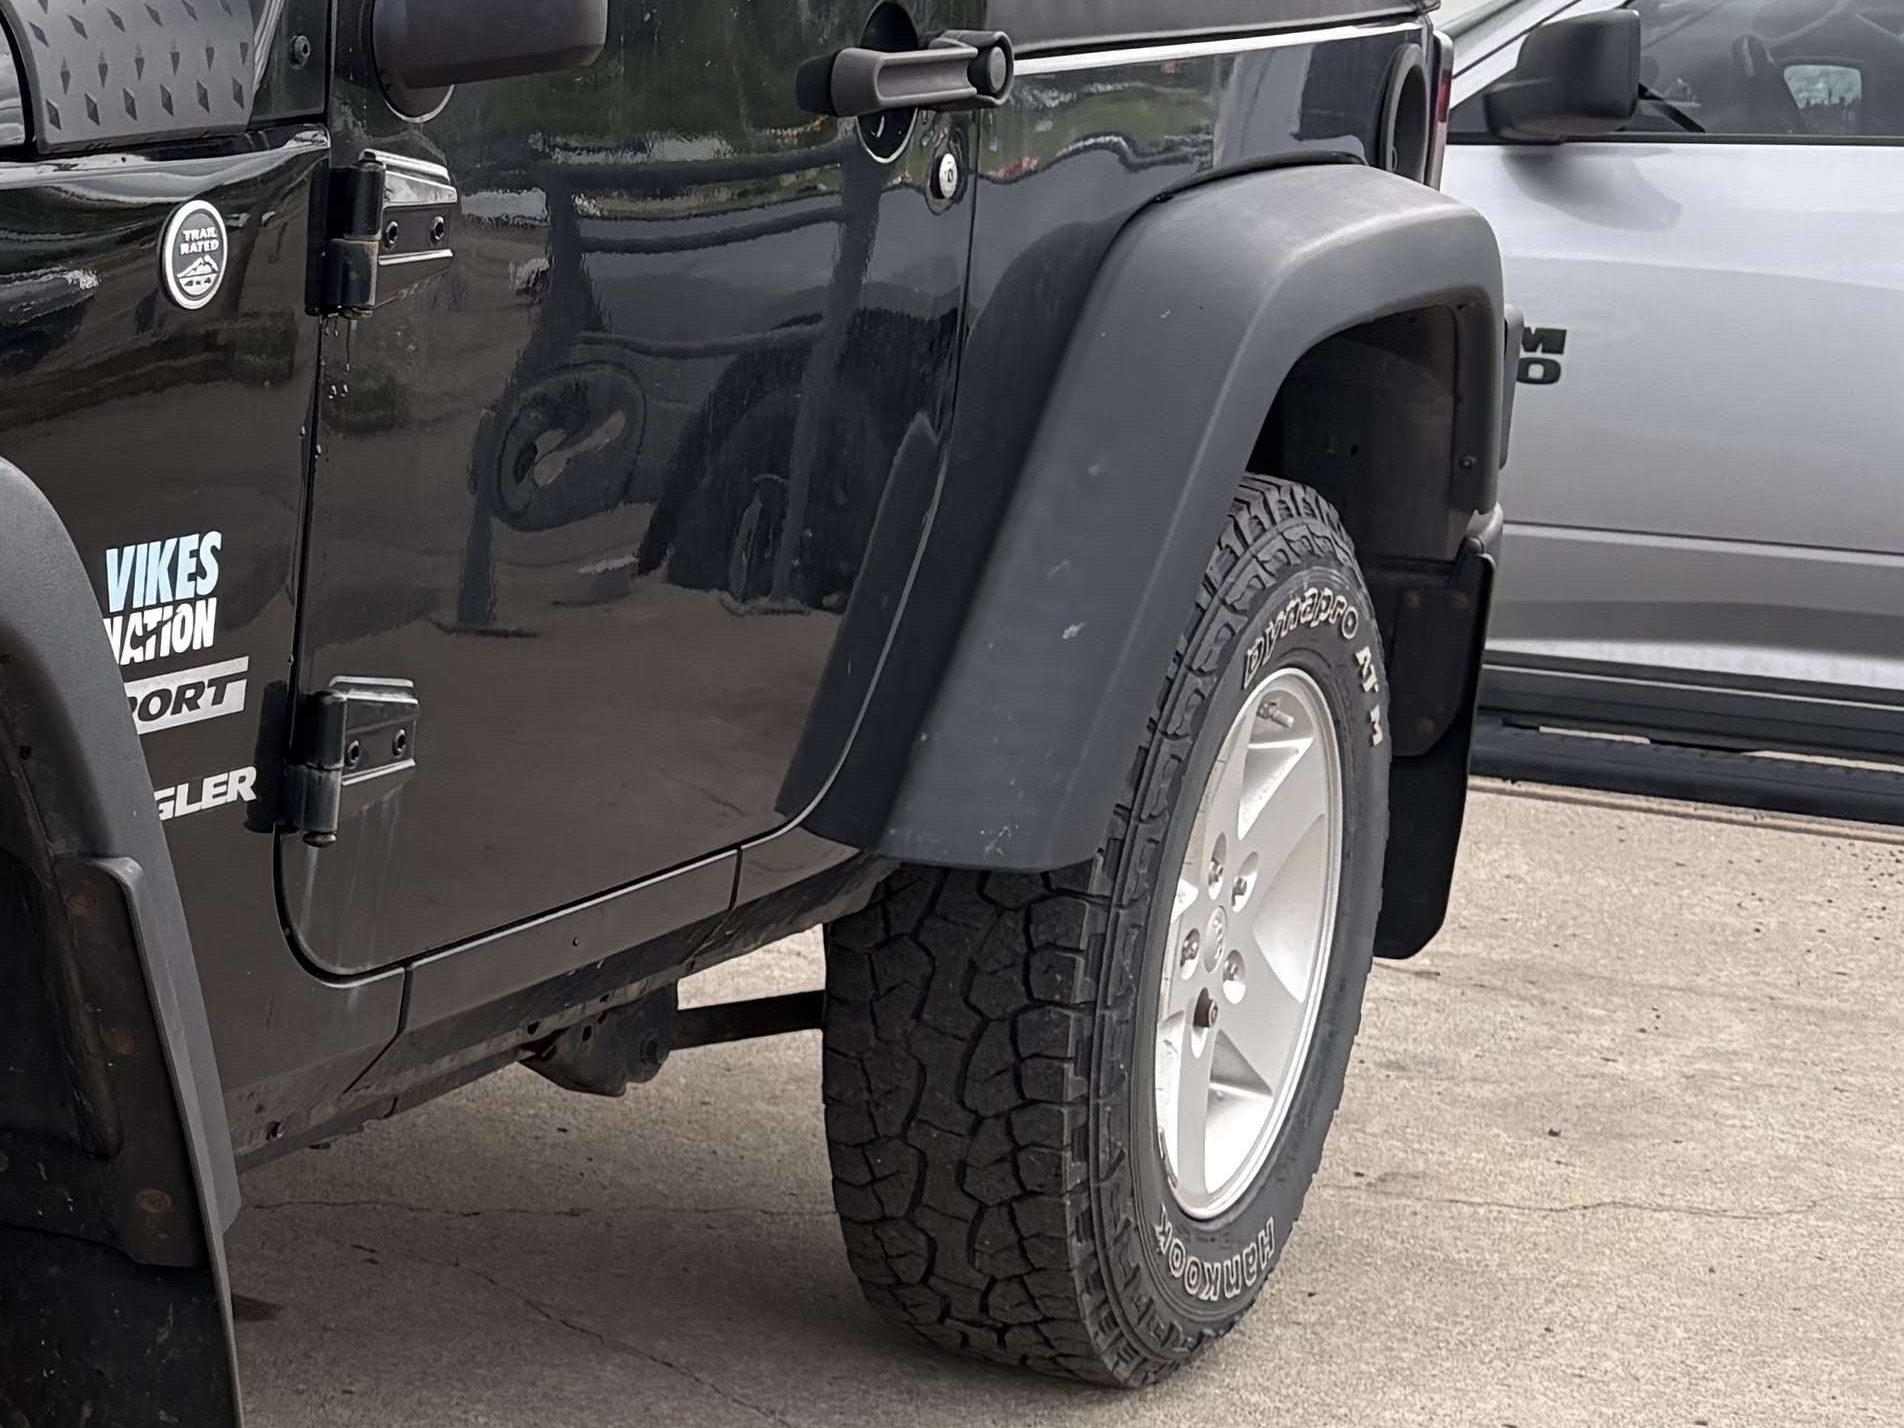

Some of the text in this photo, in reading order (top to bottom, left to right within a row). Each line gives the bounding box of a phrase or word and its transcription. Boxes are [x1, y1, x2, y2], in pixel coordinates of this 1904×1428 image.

[182, 226, 218, 242] TRAIL
[180, 239, 220, 255] RATED
[105, 530, 222, 613] VIKES
